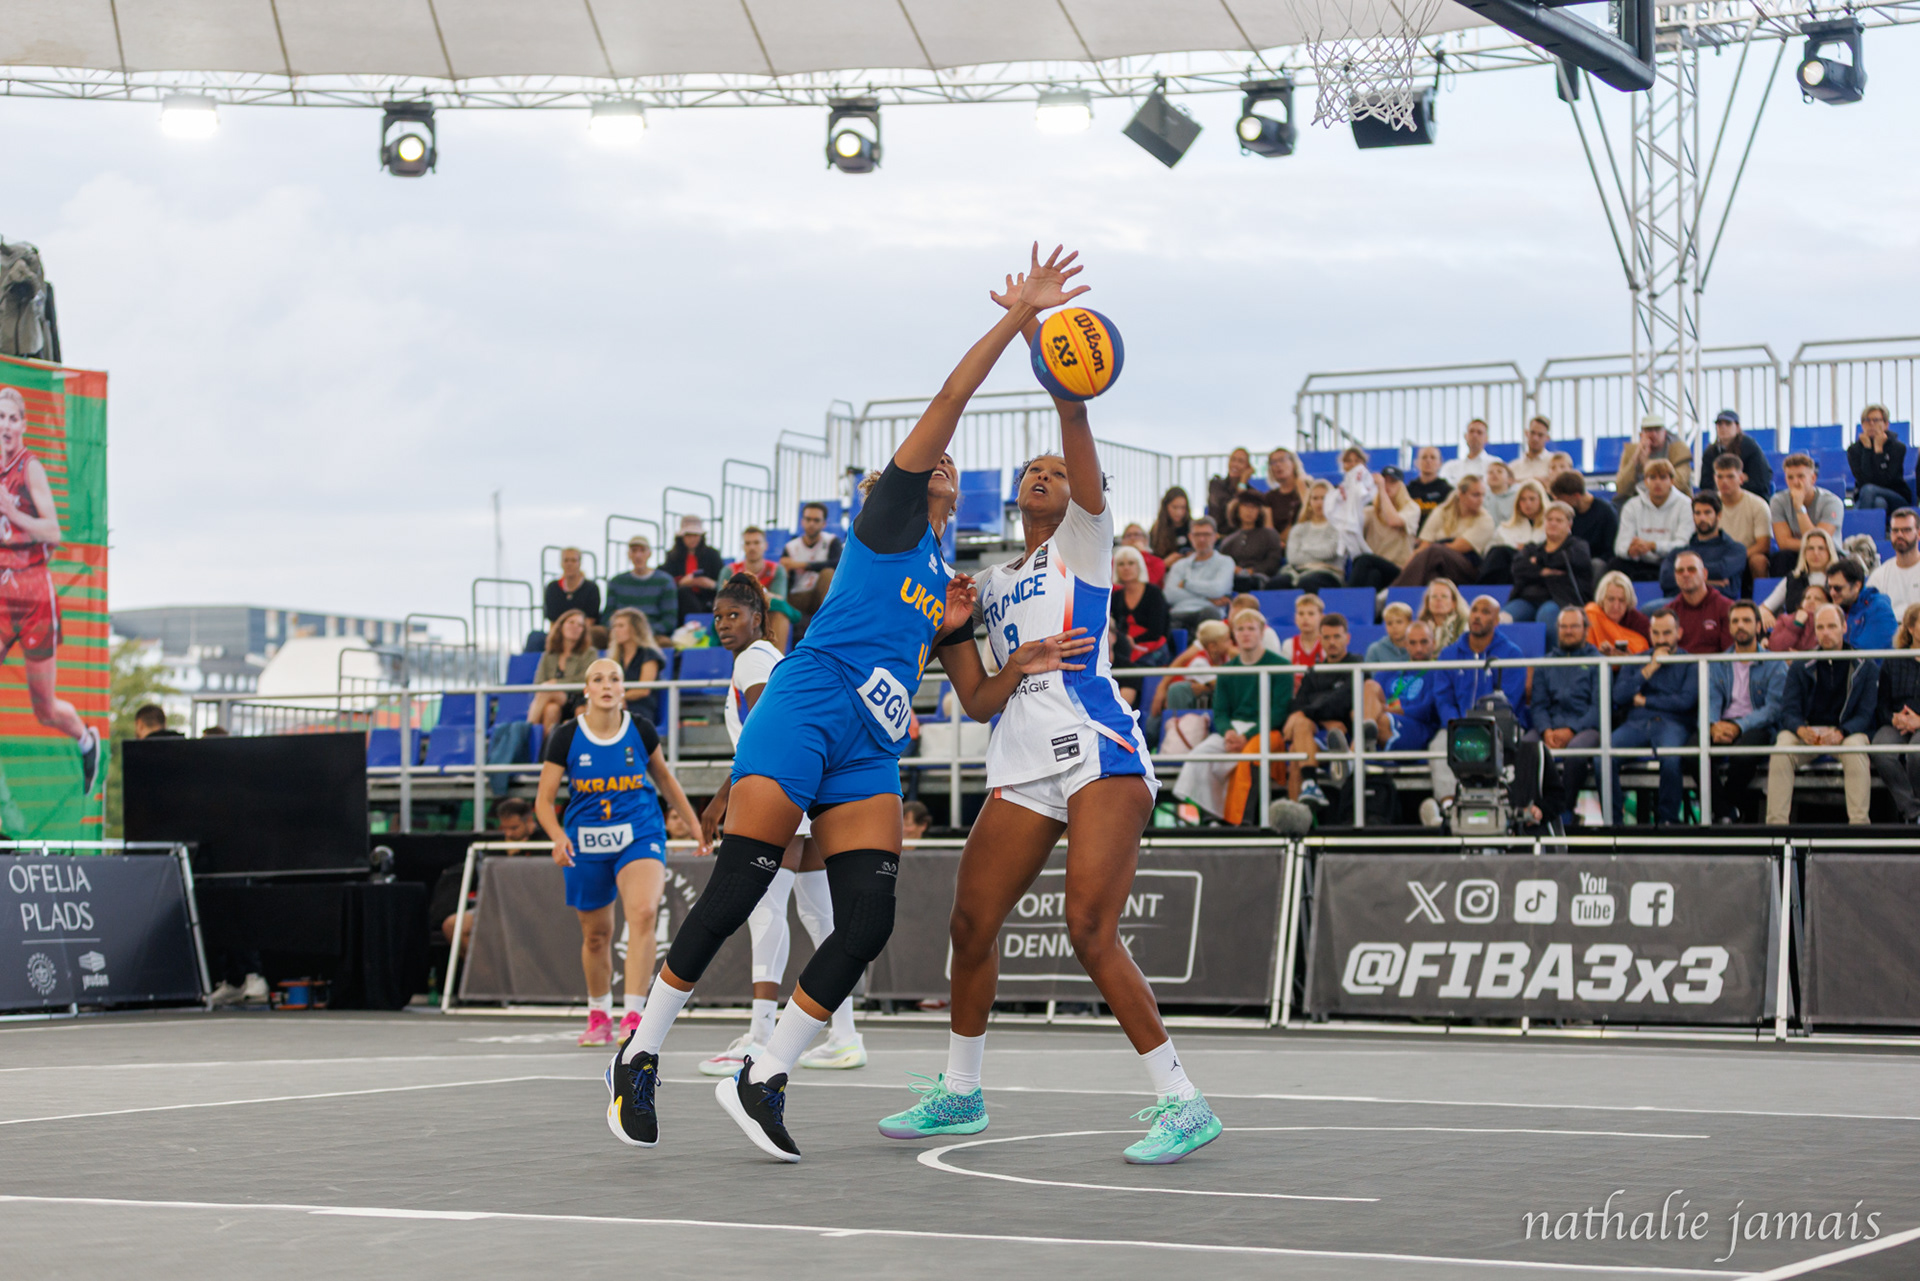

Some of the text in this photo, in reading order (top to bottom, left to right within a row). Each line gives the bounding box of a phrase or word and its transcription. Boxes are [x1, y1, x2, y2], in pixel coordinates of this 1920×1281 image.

[1073, 312, 1105, 376] Wilson
[900, 576, 945, 632] UKR
[984, 573, 1047, 634] FRANCE
[1003, 623, 1020, 655] 8
[866, 677, 909, 730] BGV
[571, 774, 644, 793] UKRAINE
[583, 831, 624, 848] BGV
[9, 864, 92, 894] OFELIA
[1579, 871, 1608, 894] You
[20, 901, 94, 932] PLADS
[1575, 899, 1612, 921] Tube
[1341, 941, 1730, 1004] @FIBA3x3
